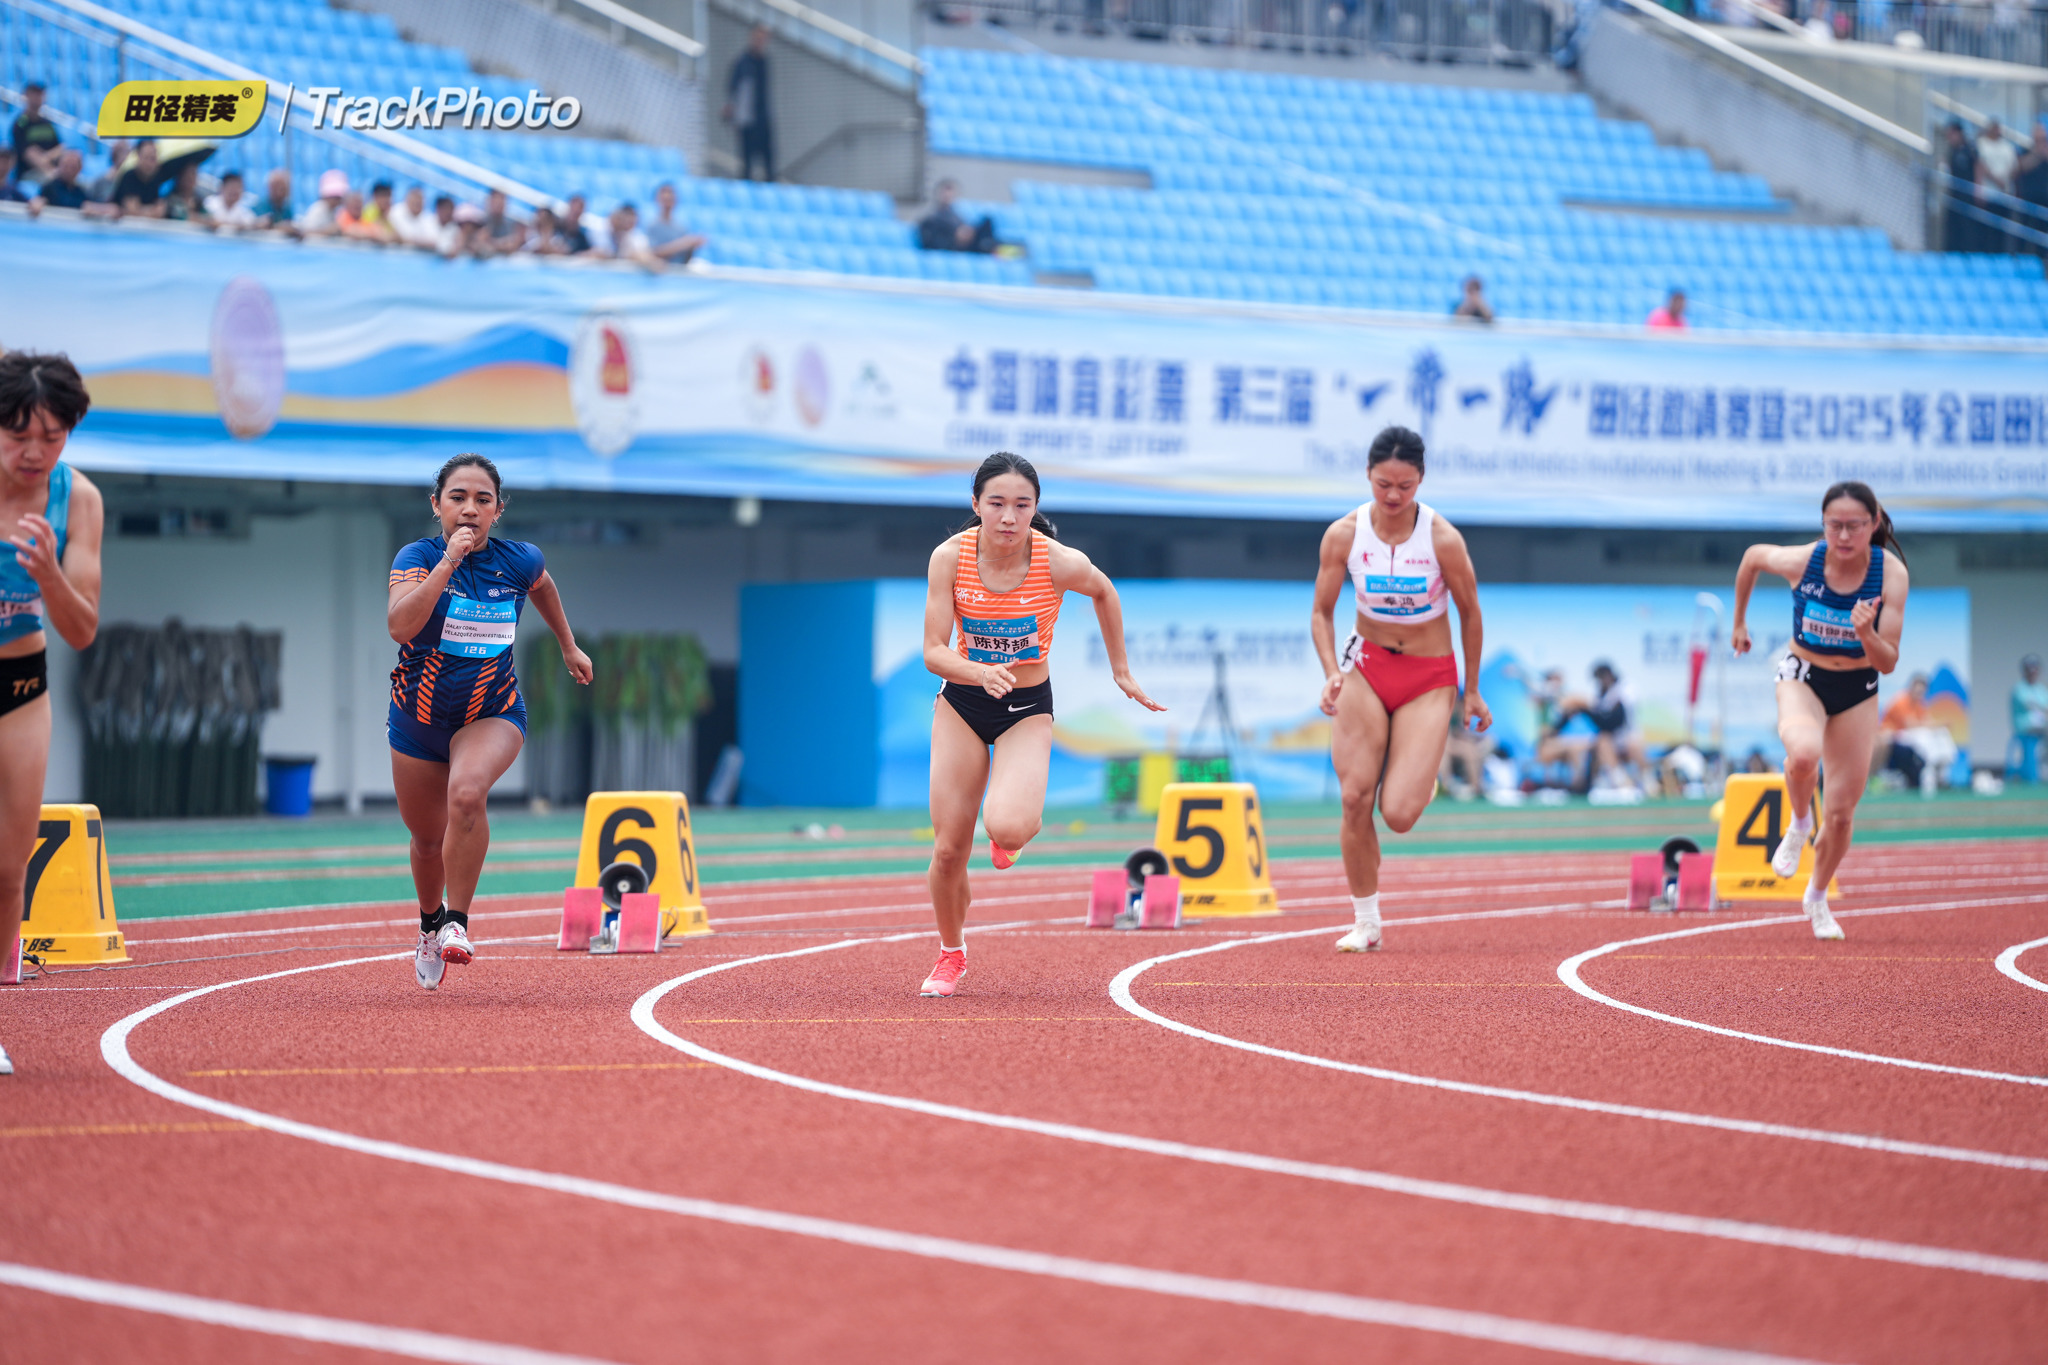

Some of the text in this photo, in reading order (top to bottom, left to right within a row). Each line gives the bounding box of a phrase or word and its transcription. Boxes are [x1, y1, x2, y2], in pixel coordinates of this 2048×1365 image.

[444, 629, 473, 638] VELAZQUEZ
[955, 588, 985, 603] 浙江
[464, 645, 487, 655] 126
[973, 635, 1029, 652] 陈妤颉
[598, 807, 657, 889] 6
[678, 806, 694, 895] 6
[1172, 798, 1225, 878] 5
[1245, 797, 1262, 878] 5
[1736, 788, 1783, 864] 4
[22, 820, 71, 921] 7
[86, 820, 105, 920] 7
